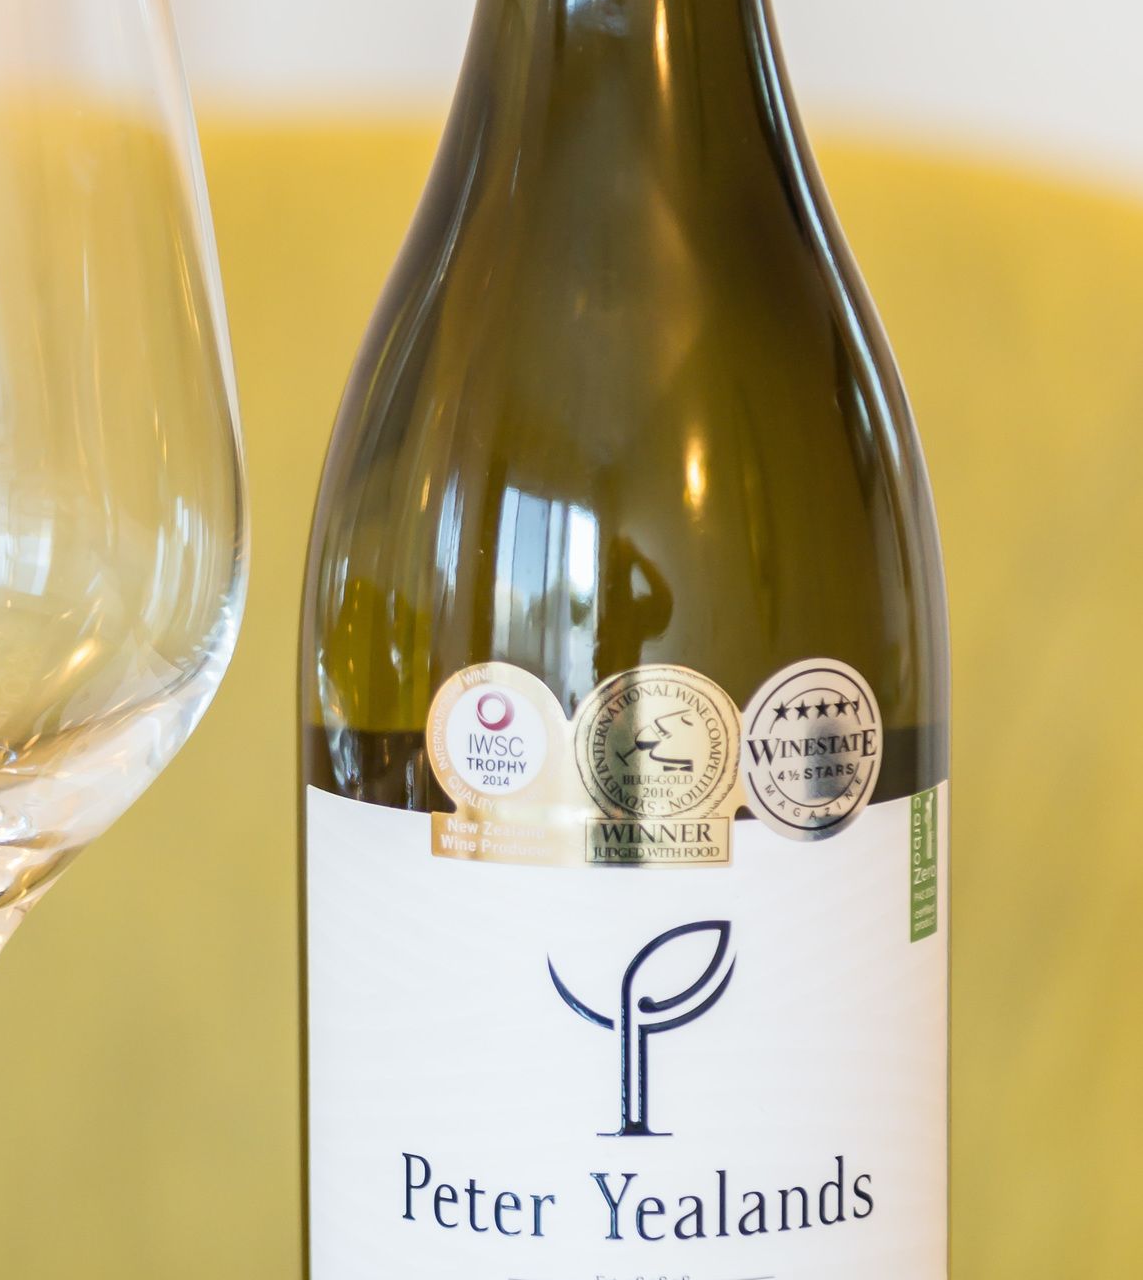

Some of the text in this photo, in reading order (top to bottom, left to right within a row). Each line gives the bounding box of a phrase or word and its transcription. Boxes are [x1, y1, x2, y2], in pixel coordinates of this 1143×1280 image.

[468, 733, 525, 758] IWSC
[593, 683, 722, 813] SYDNEY INTERNATIONAL WINE COMPETITION
[746, 729, 877, 767] WINESTATE
[466, 757, 528, 774] TROPHY
[804, 763, 855, 780] STARS
[482, 775, 510, 787] 2014
[622, 774, 694, 786] BLUE-GOLD
[447, 775, 496, 812] QUALITY
[643, 787, 674, 798] 2016
[764, 776, 863, 820] MAGAZINE
[447, 818, 479, 835] New
[600, 823, 713, 844] WINNER
[440, 834, 477, 852] Wine
[593, 846, 720, 860] JUDGED WITH FOOD
[401, 1151, 875, 1243] Peter Yealands
